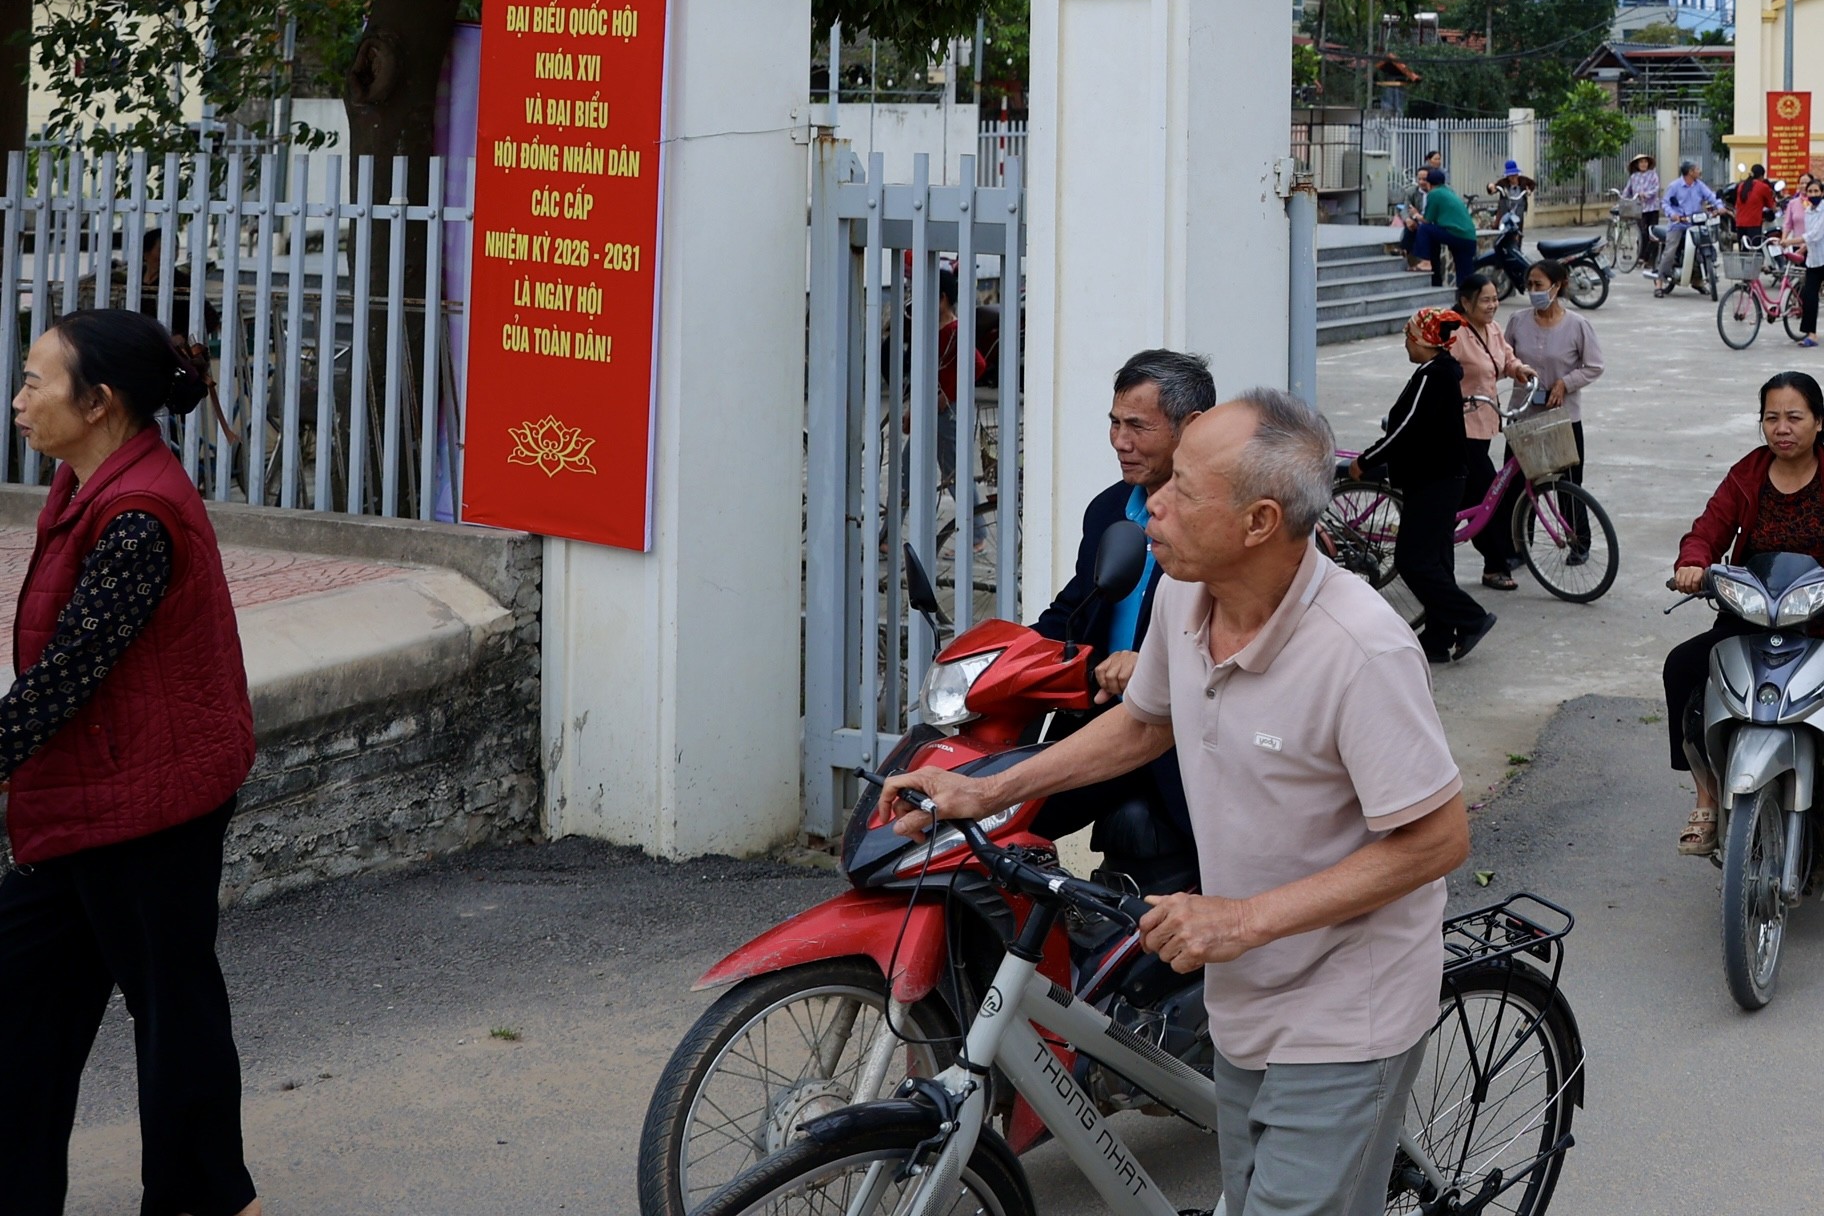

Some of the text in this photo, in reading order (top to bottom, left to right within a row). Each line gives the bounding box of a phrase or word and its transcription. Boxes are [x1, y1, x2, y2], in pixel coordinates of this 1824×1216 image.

[507, 5, 529, 37] ĐẠI
[569, 0, 608, 37] QUỐC
[612, 5, 637, 43] HỘI
[536, 48, 600, 81] KHÓA XVI
[526, 91, 608, 131] VÀ ĐẠI BIỂU
[494, 135, 640, 177] HỘI ĐỒNG NHÂN DÂN
[532, 184, 593, 220] CÁC CẤP
[485, 228, 529, 265] NHIỆM
[532, 231, 551, 263] KỲ
[554, 238, 589, 267] 2026
[604, 243, 639, 271] 2031
[514, 275, 602, 320] LÀ NGÀY HỘI
[503, 314, 611, 362] CỦA TOÀN DÂN!
